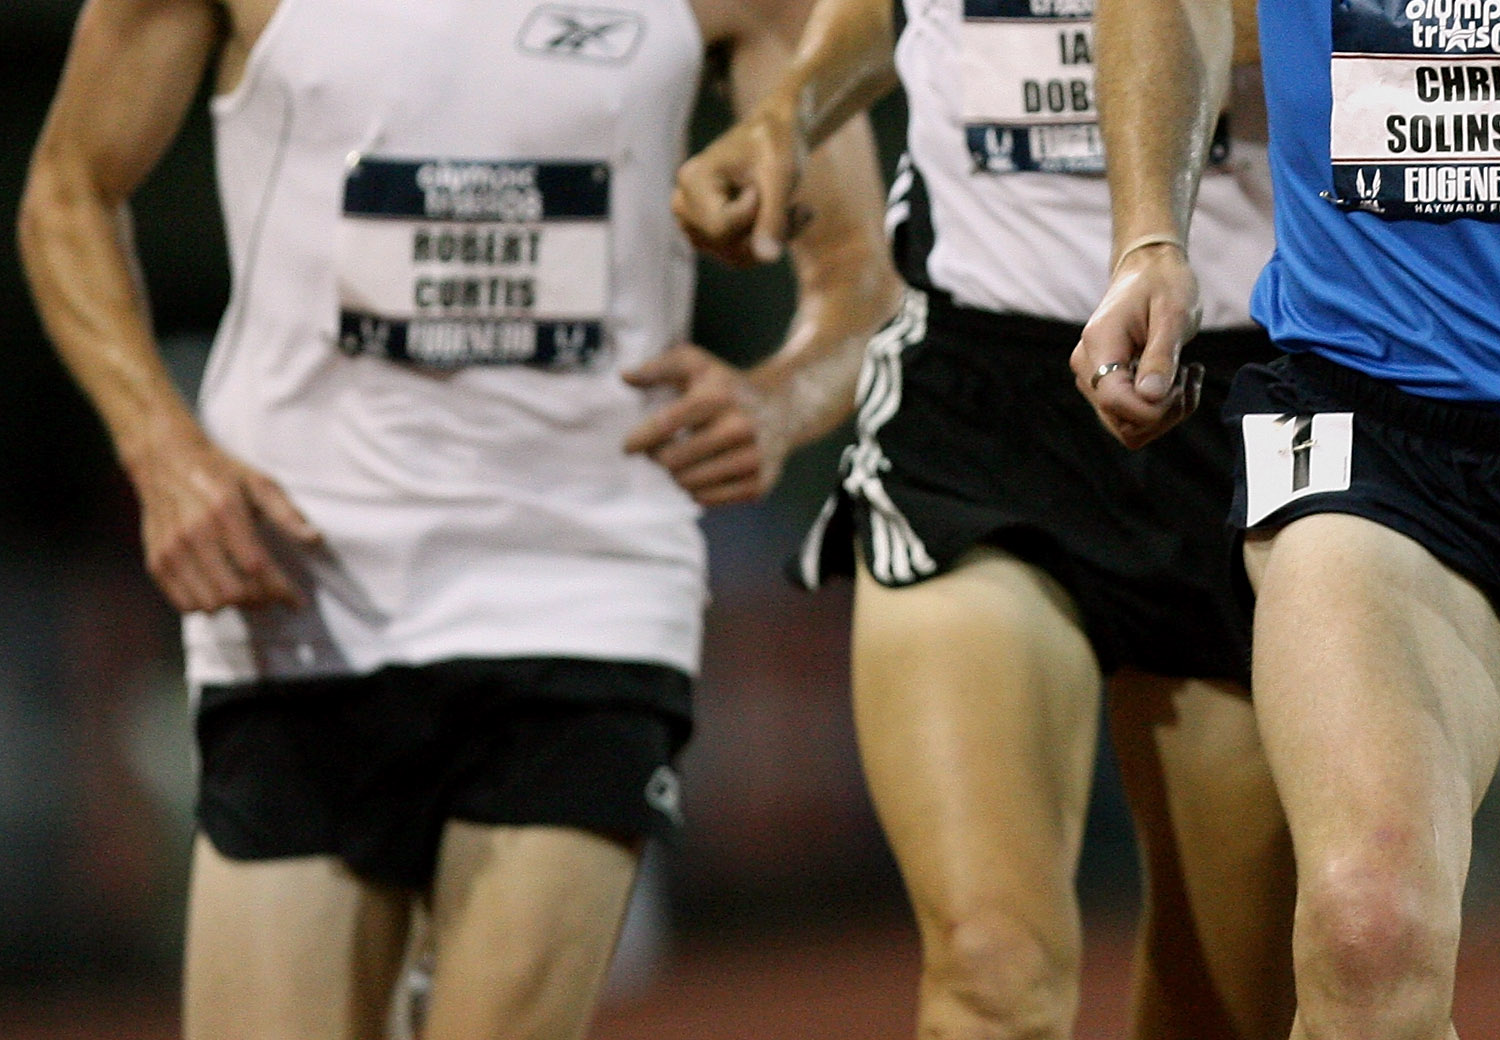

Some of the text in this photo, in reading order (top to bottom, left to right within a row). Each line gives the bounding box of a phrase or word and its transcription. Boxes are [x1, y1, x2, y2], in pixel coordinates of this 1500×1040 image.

[1060, 32, 1093, 65] IA
[1023, 79, 1090, 112] DOB
[1414, 202, 1484, 214] HAYWARD
